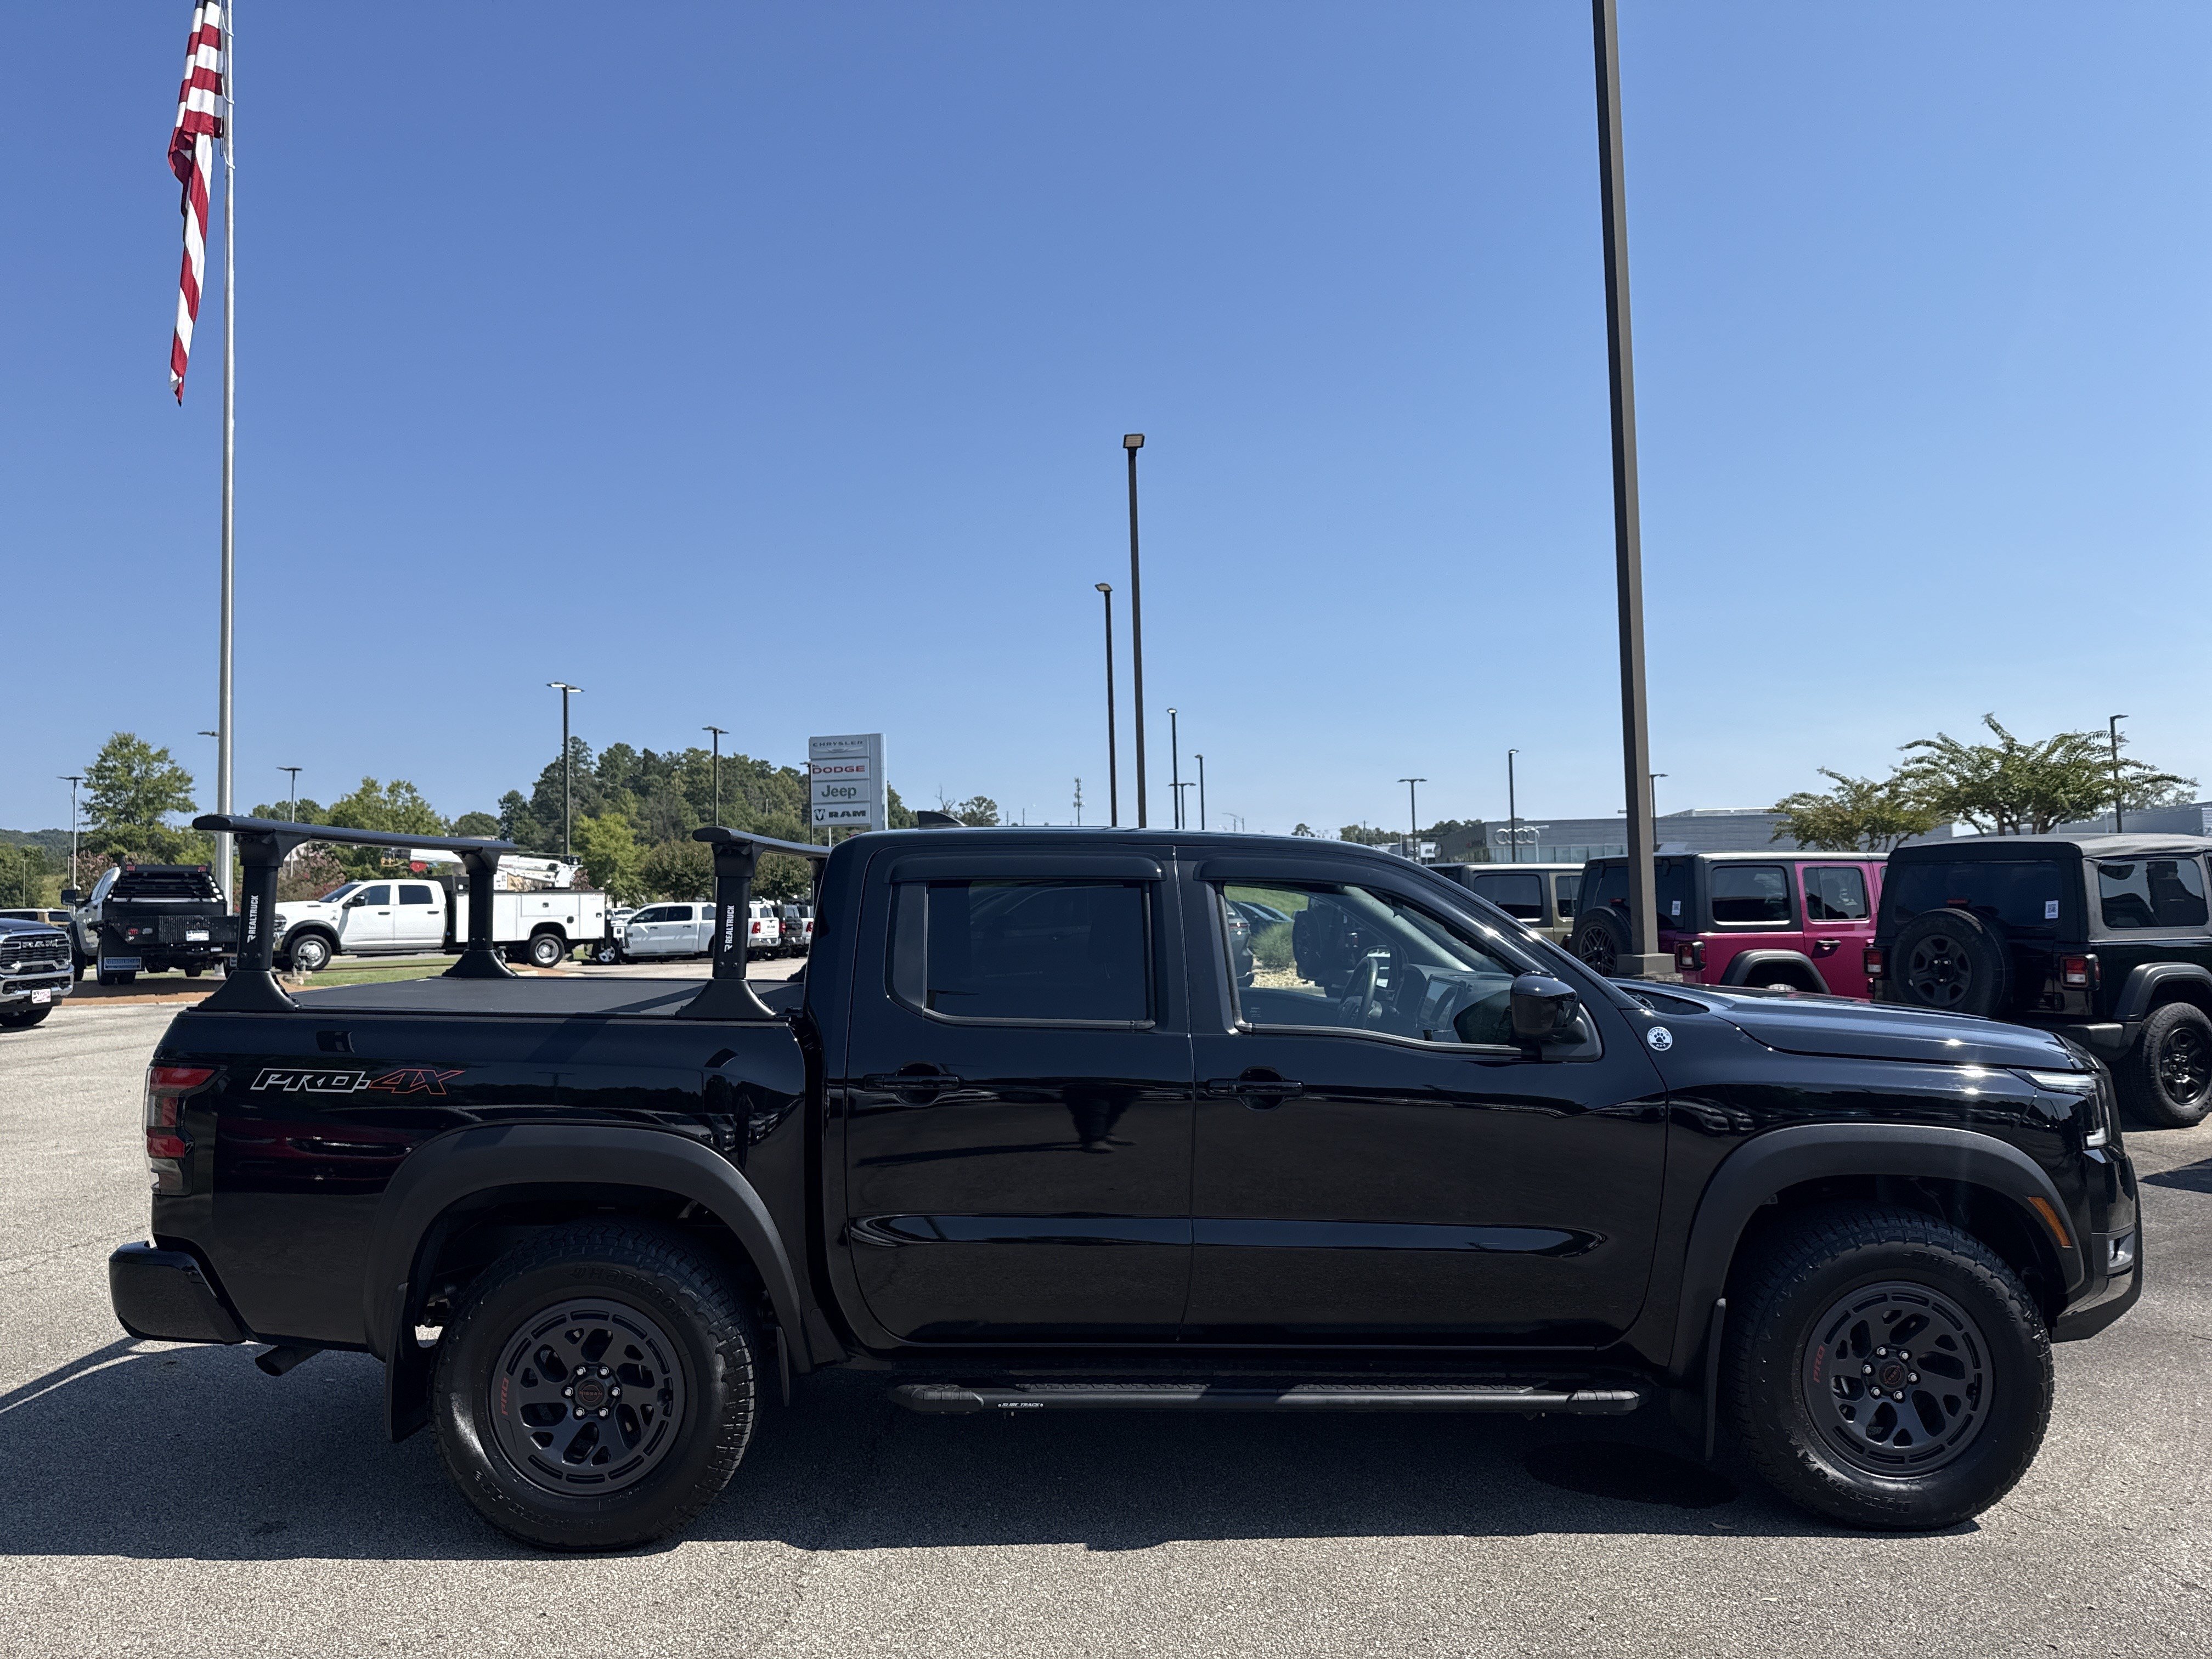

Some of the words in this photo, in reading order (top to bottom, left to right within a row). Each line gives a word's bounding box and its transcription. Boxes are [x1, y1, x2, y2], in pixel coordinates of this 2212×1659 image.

[812, 765, 865, 774] DODGE
[821, 785, 857, 799] Jeep
[249, 895, 259, 935] REALTRUCK
[725, 905, 735, 944] REALTRUCK
[1813, 1345, 1825, 1383] PRO
[501, 1378, 509, 1415] PRO
